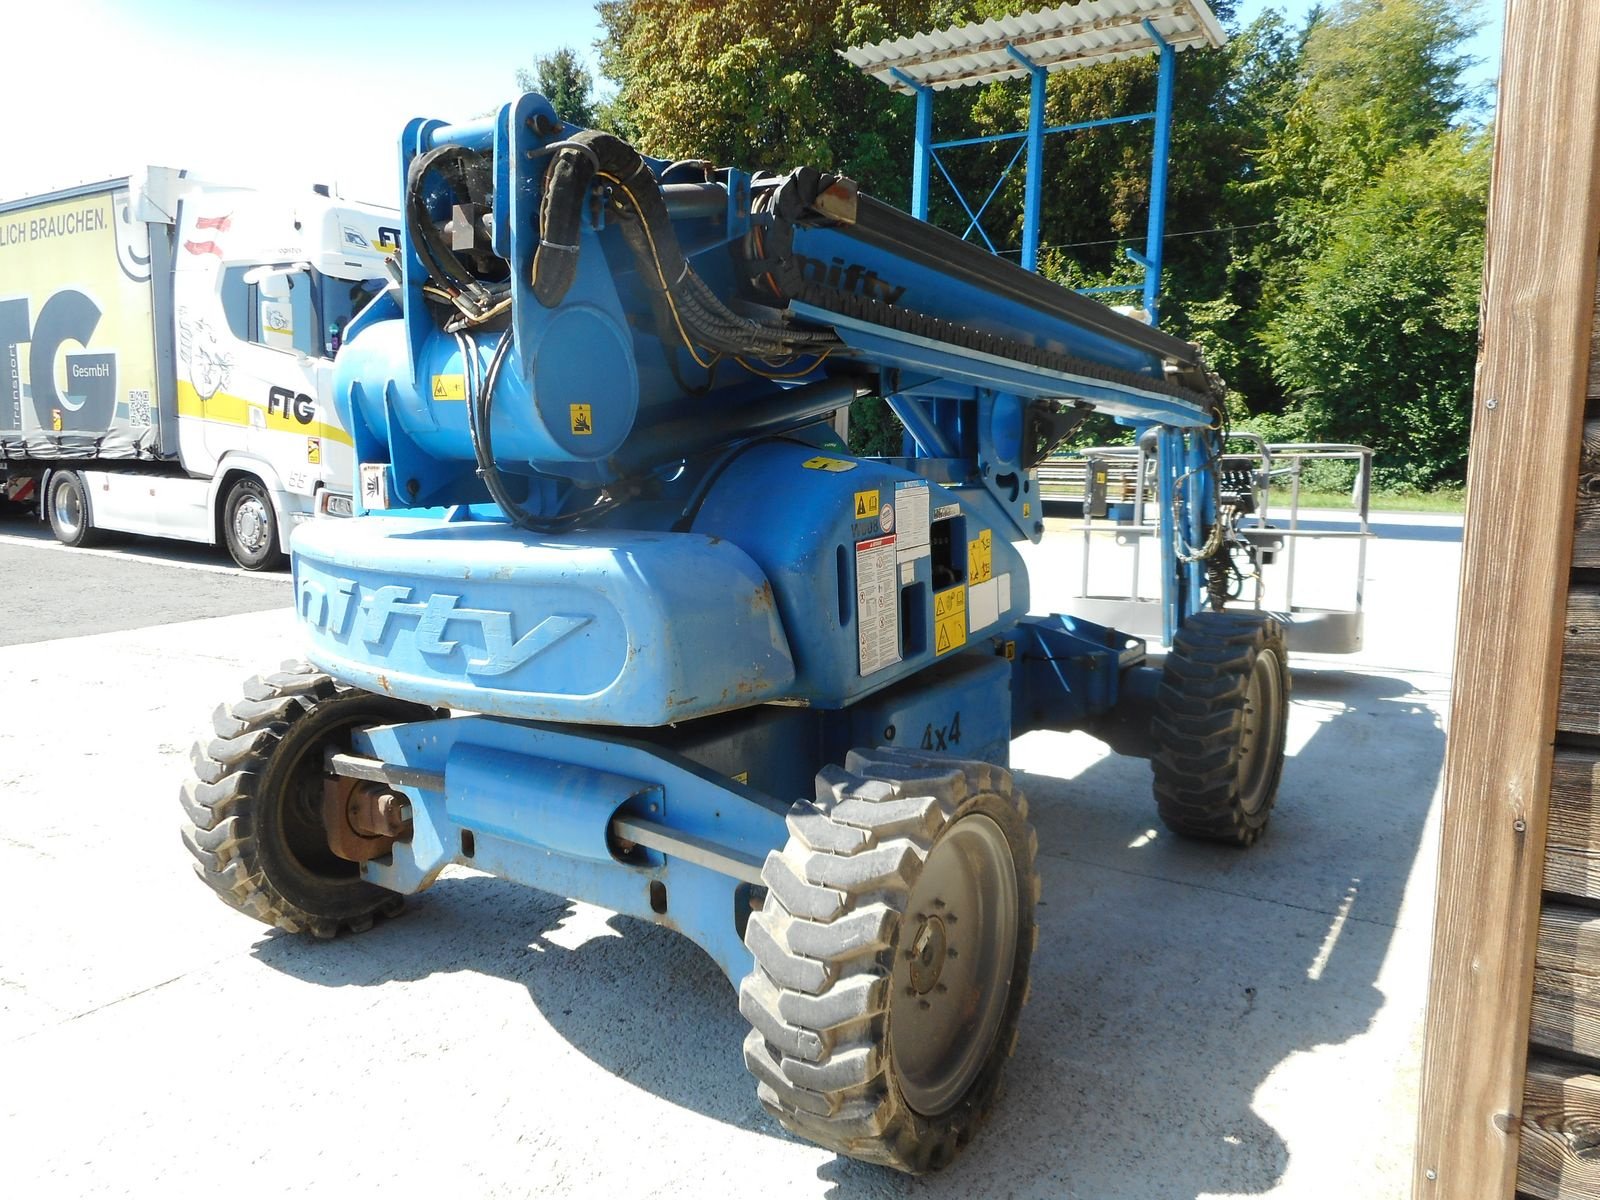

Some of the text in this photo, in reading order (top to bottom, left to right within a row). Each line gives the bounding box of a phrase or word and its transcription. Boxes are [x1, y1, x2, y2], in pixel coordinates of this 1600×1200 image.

[30, 207, 107, 241] BRAUCHEN.
[378, 226, 402, 249] FT
[795, 254, 907, 304] nifty
[8, 343, 20, 427] Transport
[72, 364, 110, 378] GesmbH
[267, 385, 316, 425] FTG
[300, 577, 594, 677] nifty
[920, 710, 961, 751] 4x4
